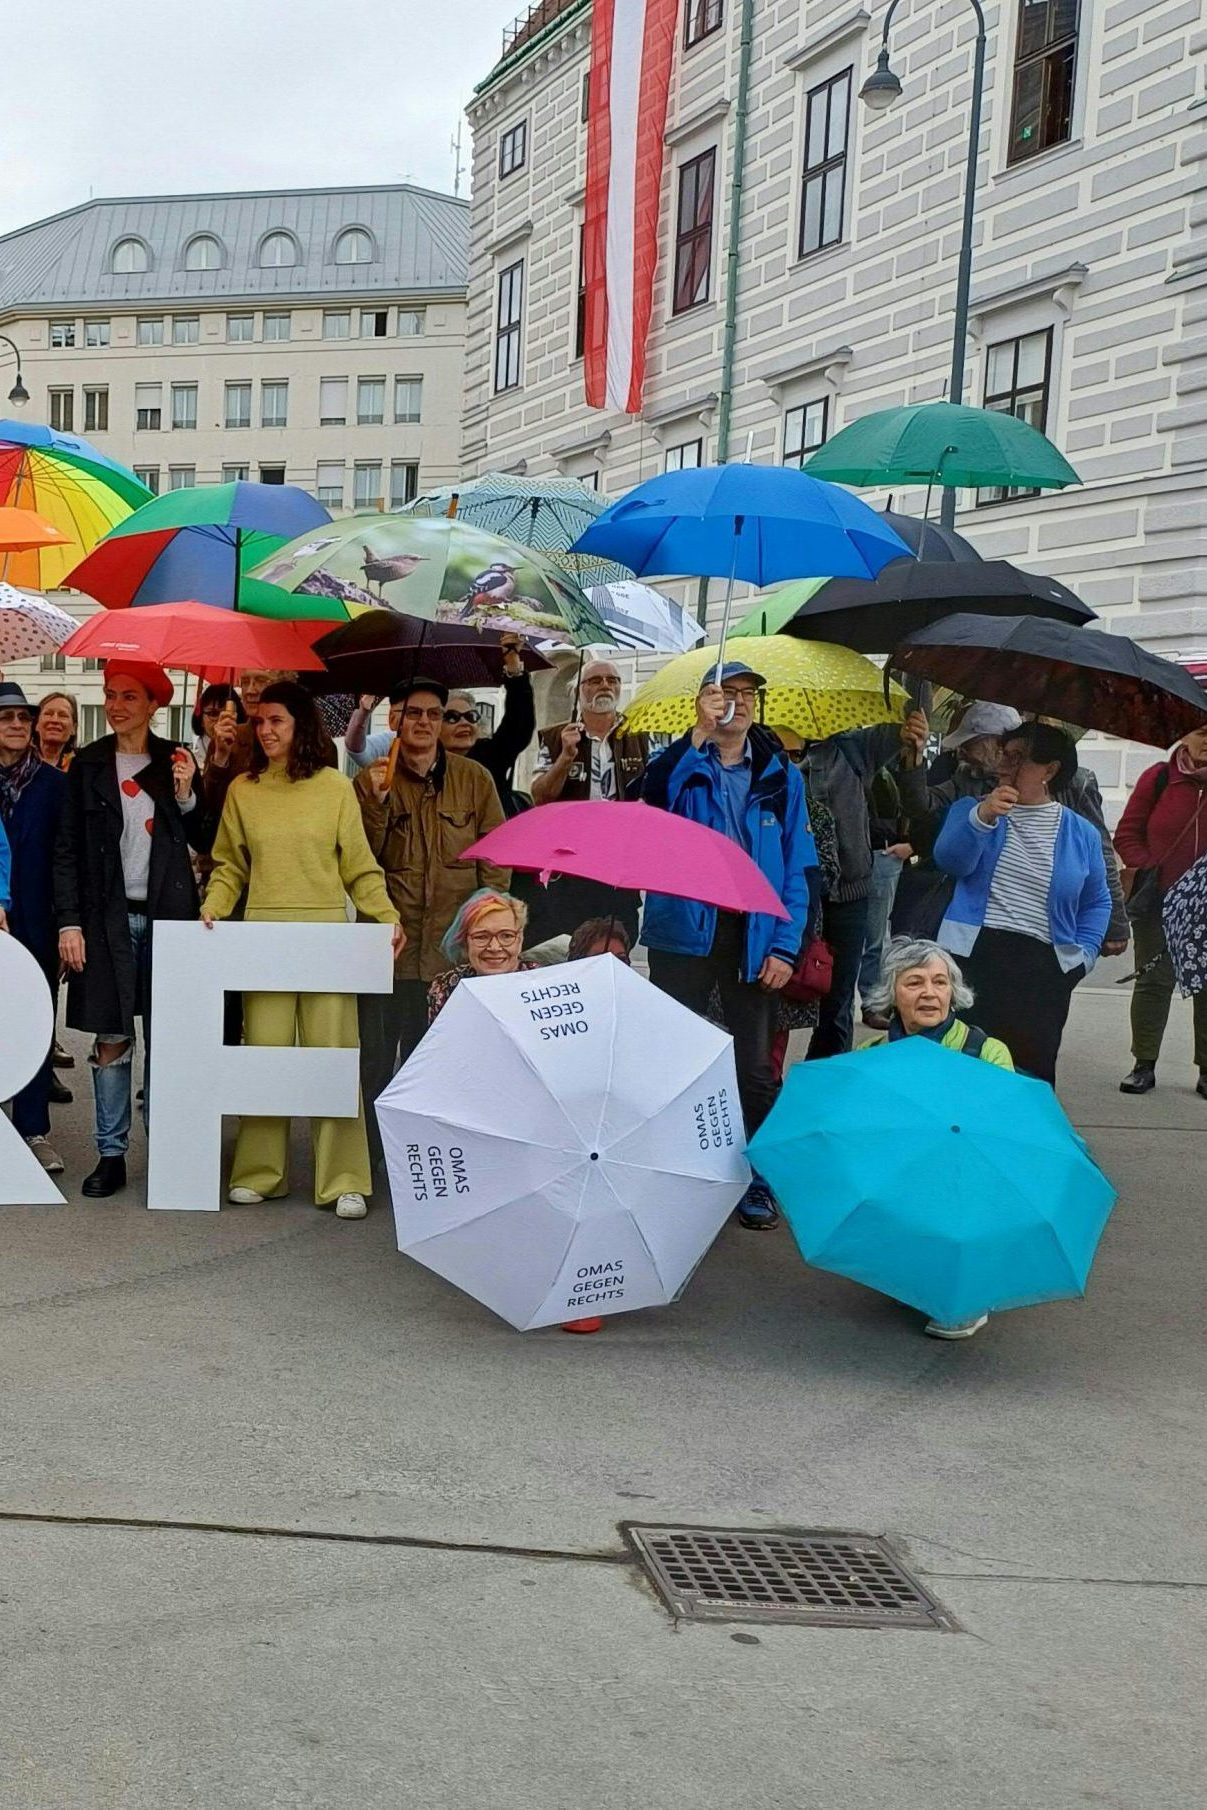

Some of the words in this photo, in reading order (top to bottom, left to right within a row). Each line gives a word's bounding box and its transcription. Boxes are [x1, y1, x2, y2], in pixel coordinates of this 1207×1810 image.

[520, 982, 582, 1005] RECHTS
[530, 1001, 585, 1022] GEGEN
[539, 1020, 589, 1041] OMAS
[694, 1103, 710, 1150] OMAS
[707, 1095, 723, 1148] GEGEN
[718, 1088, 735, 1147] RECHTS
[406, 1143, 429, 1202] RECHTS
[427, 1145, 449, 1198] GEGEN
[449, 1147, 471, 1194] OMAS
[572, 1275, 625, 1293] GEGEN
[576, 1259, 624, 1279] OMAS
[566, 1288, 626, 1308] RECHTS
